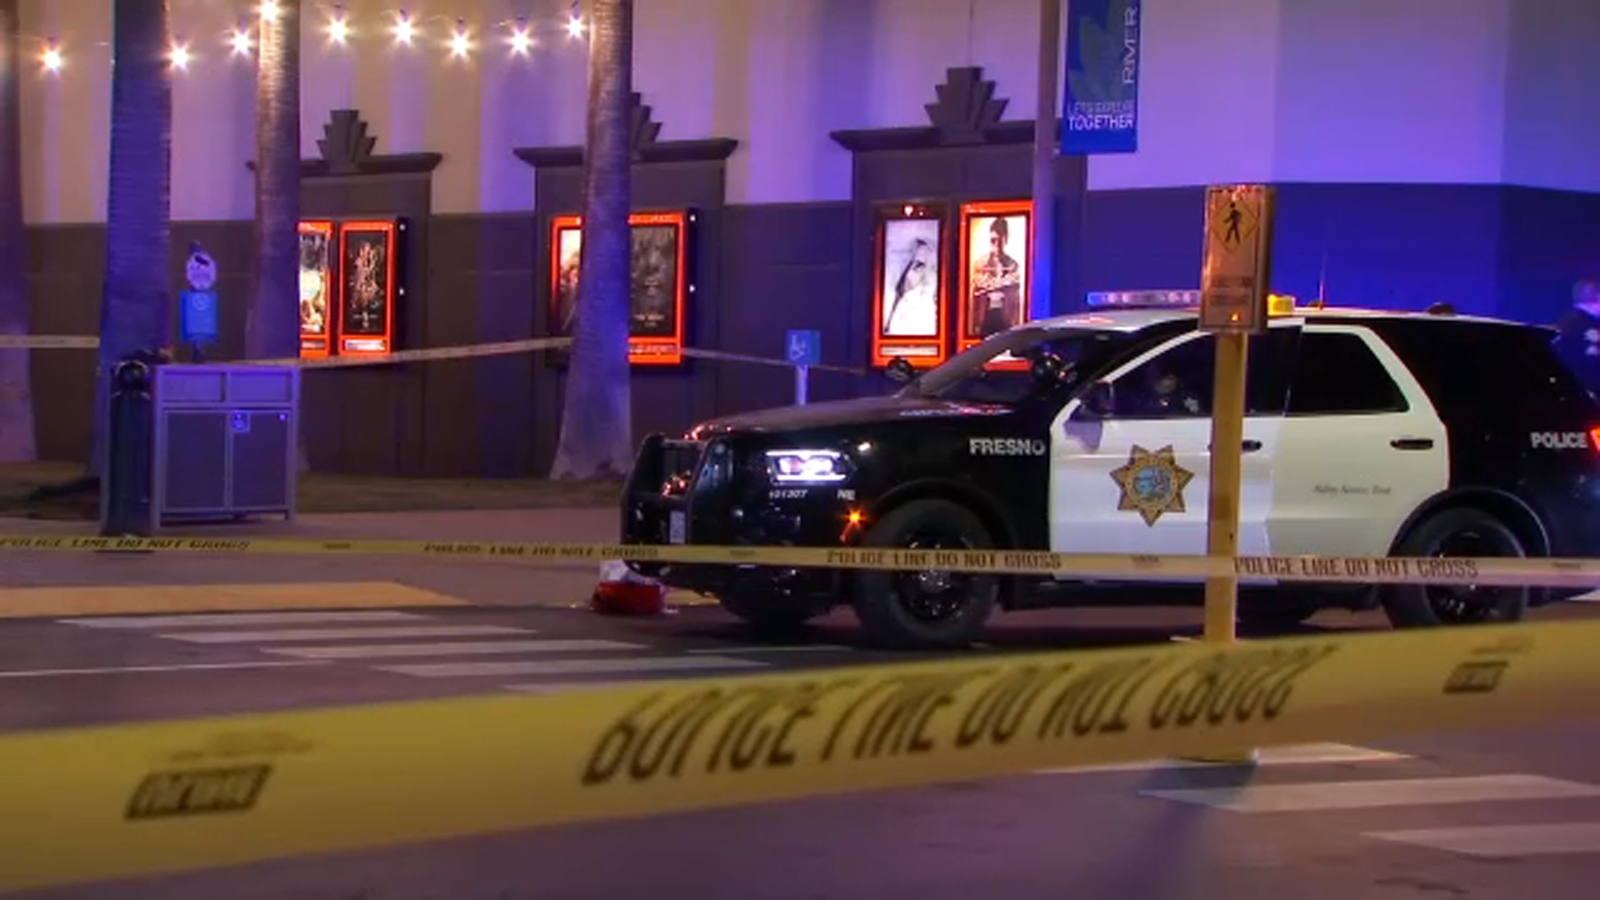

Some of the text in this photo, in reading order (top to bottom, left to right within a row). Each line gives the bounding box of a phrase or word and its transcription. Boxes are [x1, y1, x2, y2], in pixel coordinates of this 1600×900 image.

[1122, 6, 1138, 84] RIVER
[1068, 114, 1134, 131] TOGETHER
[969, 438, 1046, 456] FRESNO
[1530, 431, 1589, 448] POLICE
[826, 550, 1063, 570] POLICE LINE DO NOT CROSS
[1233, 556, 1480, 579] POLICE LINE DO NOT CROSS
